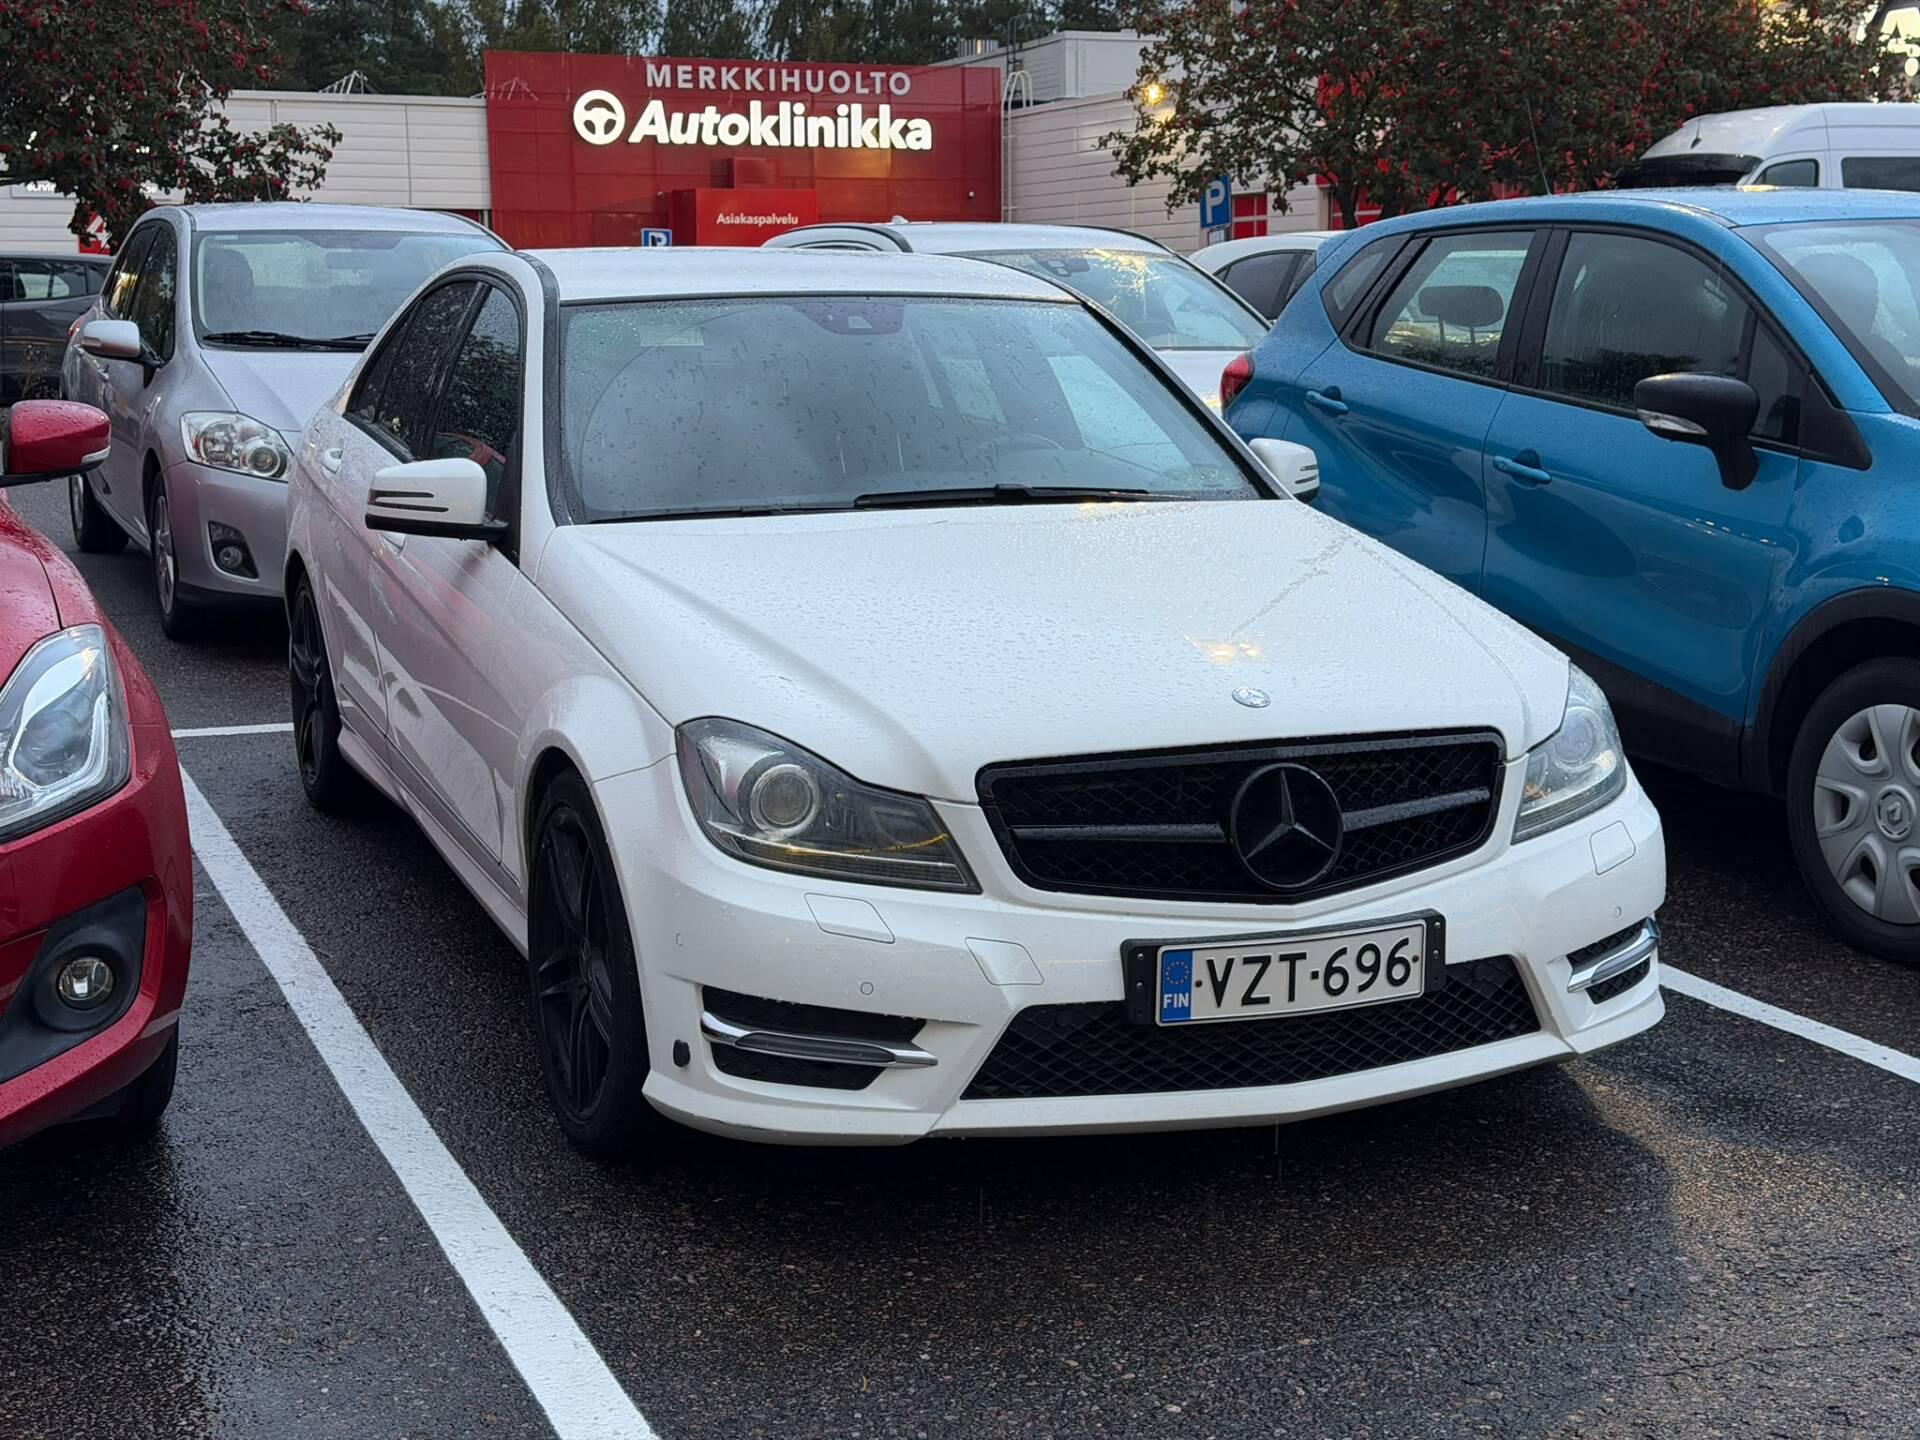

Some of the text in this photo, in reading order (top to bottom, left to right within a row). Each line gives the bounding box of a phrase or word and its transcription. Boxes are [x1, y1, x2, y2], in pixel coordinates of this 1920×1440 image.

[646, 63, 911, 96] MERKKIHUOLTO
[628, 99, 933, 151] Autoklinikka
[1205, 180, 1226, 225] P
[716, 212, 799, 227] Asiakaspalvelu
[1163, 992, 1189, 1009] FIN
